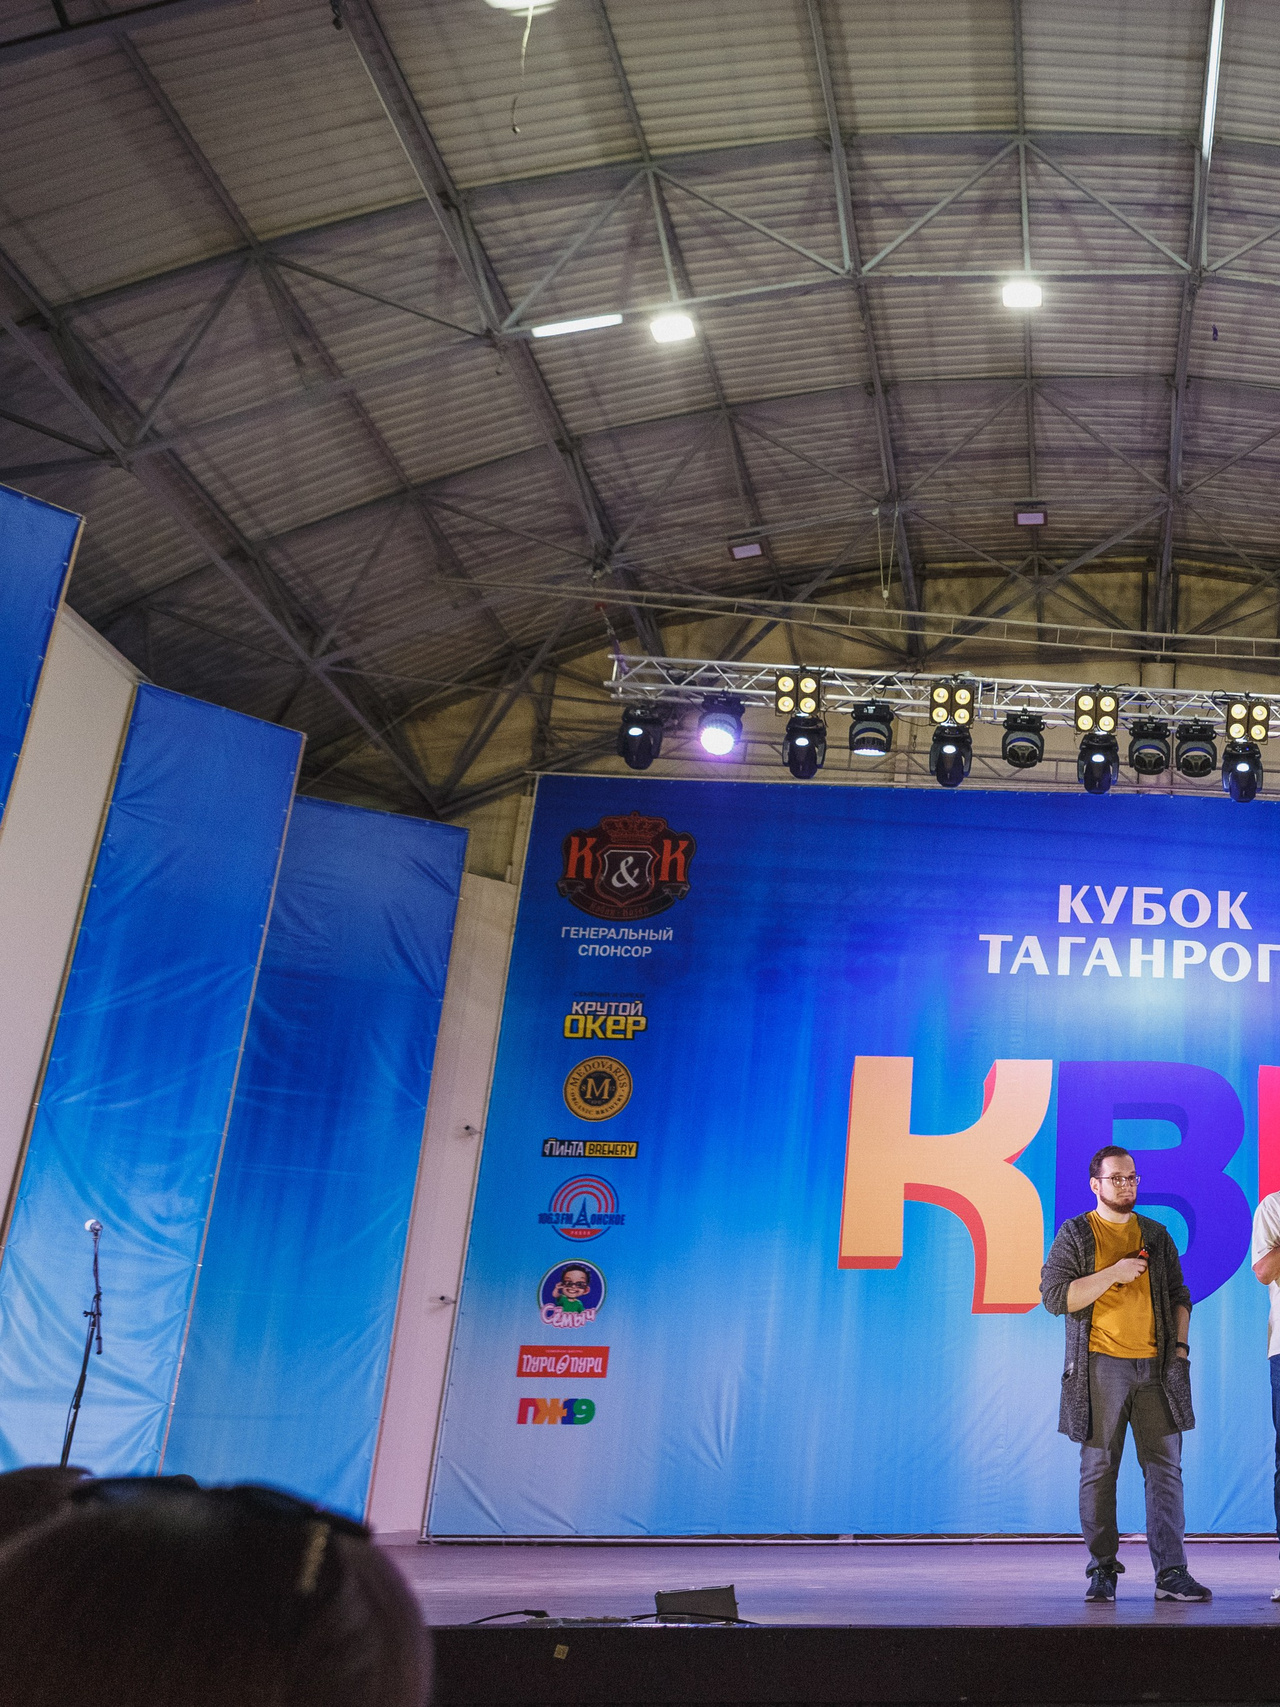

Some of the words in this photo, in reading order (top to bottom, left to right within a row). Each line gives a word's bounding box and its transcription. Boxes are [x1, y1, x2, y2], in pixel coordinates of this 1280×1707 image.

[1057, 884, 1252, 930] КУБОК
[561, 926, 674, 941] ГЕНЕРАЛЬНЫЙ
[578, 944, 652, 958] СПОНСОР
[571, 1000, 643, 1016] КРУТОЙ
[570, 1060, 628, 1089] MEDOVARUS
[584, 1078, 612, 1099] M
[588, 1143, 635, 1155] BREWERY
